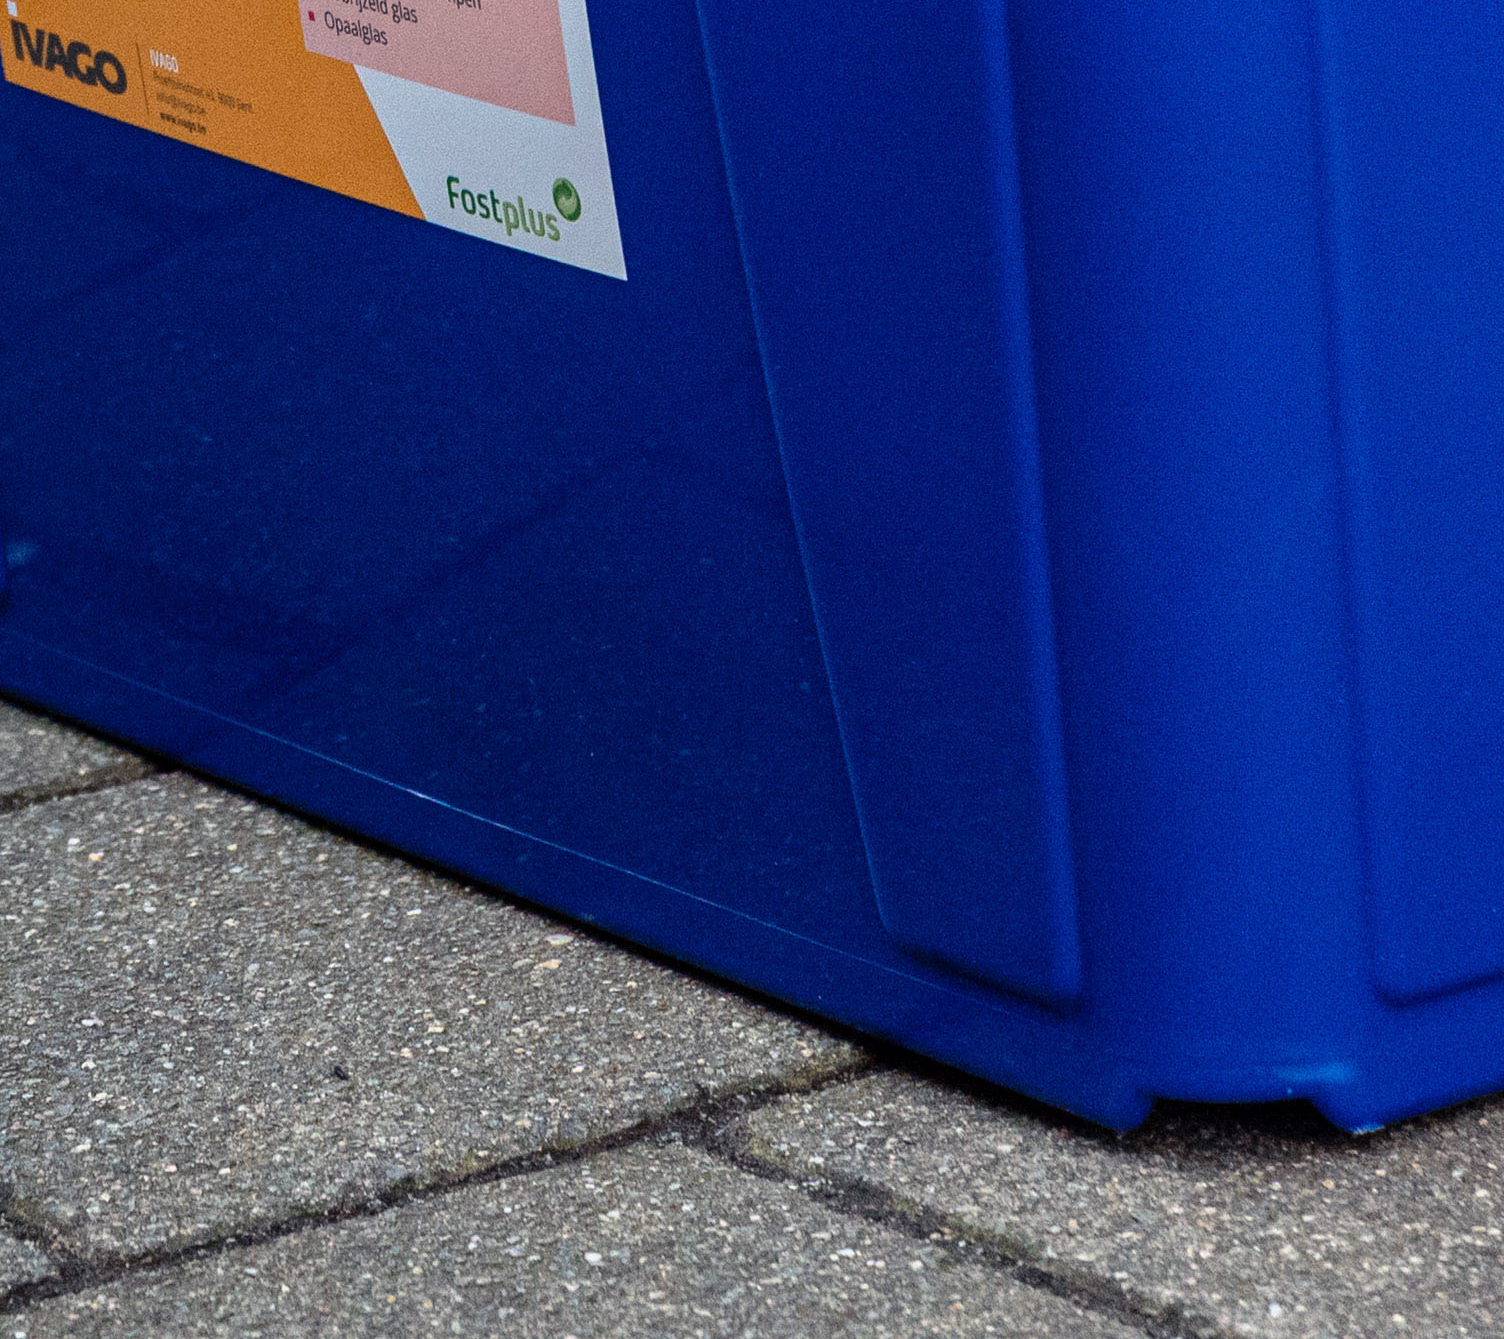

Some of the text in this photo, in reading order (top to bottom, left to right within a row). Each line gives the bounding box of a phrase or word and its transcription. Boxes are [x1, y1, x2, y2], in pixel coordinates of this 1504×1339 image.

[392, 1, 418, 24] glas
[324, 11, 388, 45] Opaalglas
[149, 49, 179, 73] IVAGO
